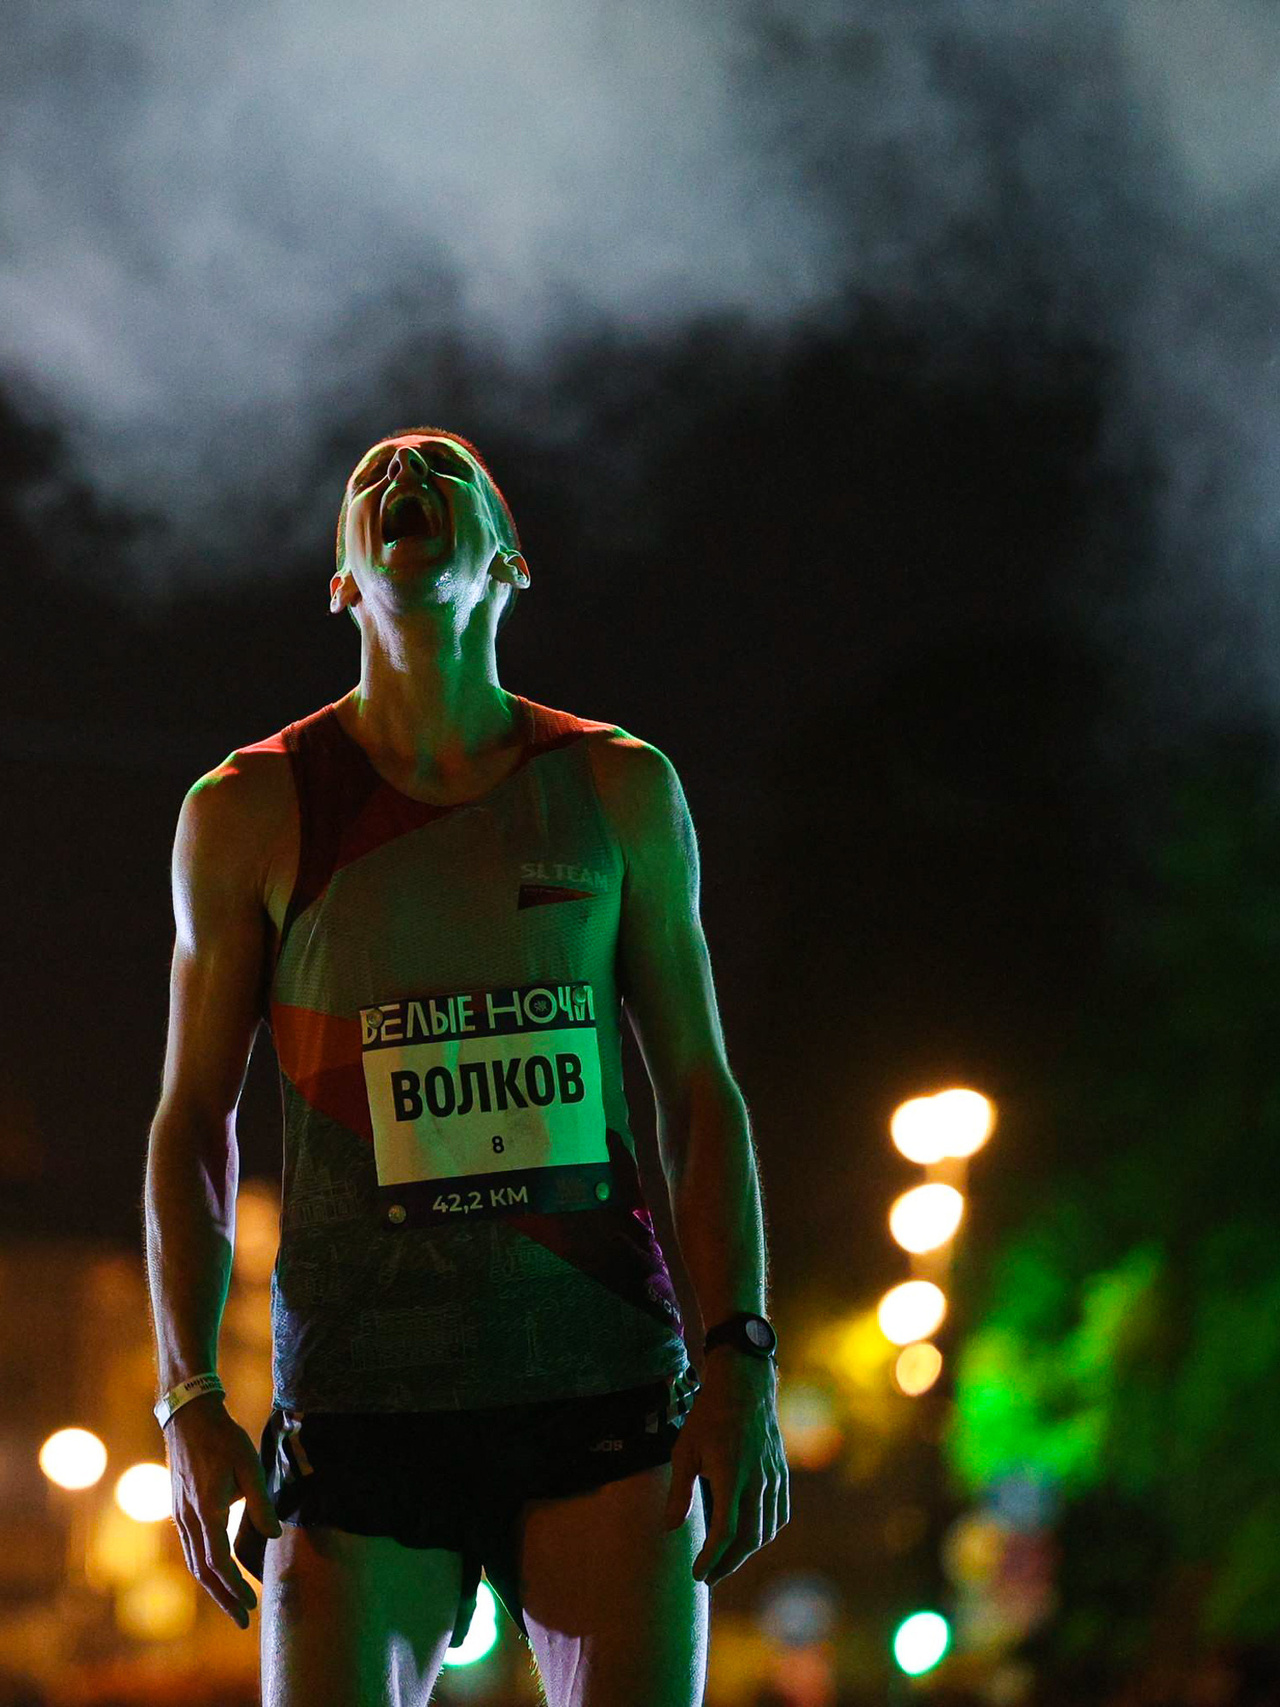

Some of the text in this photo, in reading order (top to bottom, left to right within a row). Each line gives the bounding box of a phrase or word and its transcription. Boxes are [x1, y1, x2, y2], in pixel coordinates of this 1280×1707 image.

[360, 985, 595, 1045] БЕЛЫЕ НОЧИ
[391, 1053, 586, 1122] ВОЛКОВ
[491, 1135, 505, 1154] 8
[432, 1185, 528, 1214] 42,2 КМ
